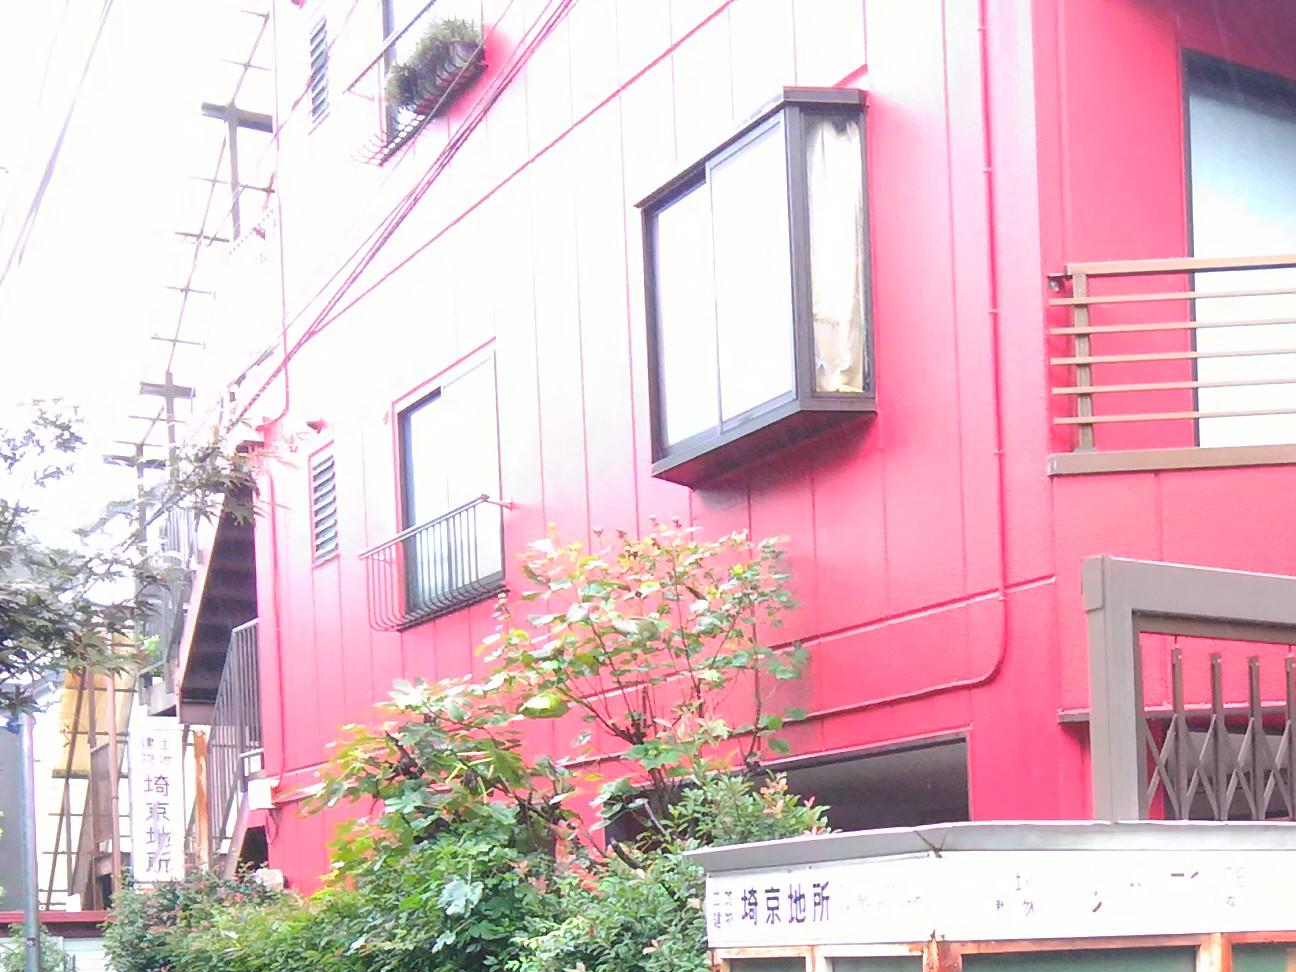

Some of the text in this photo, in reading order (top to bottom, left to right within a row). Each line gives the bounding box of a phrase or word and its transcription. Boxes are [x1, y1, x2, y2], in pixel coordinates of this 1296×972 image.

[143, 774, 171, 873] 埼京地所
[741, 881, 830, 925] 埼京地所
